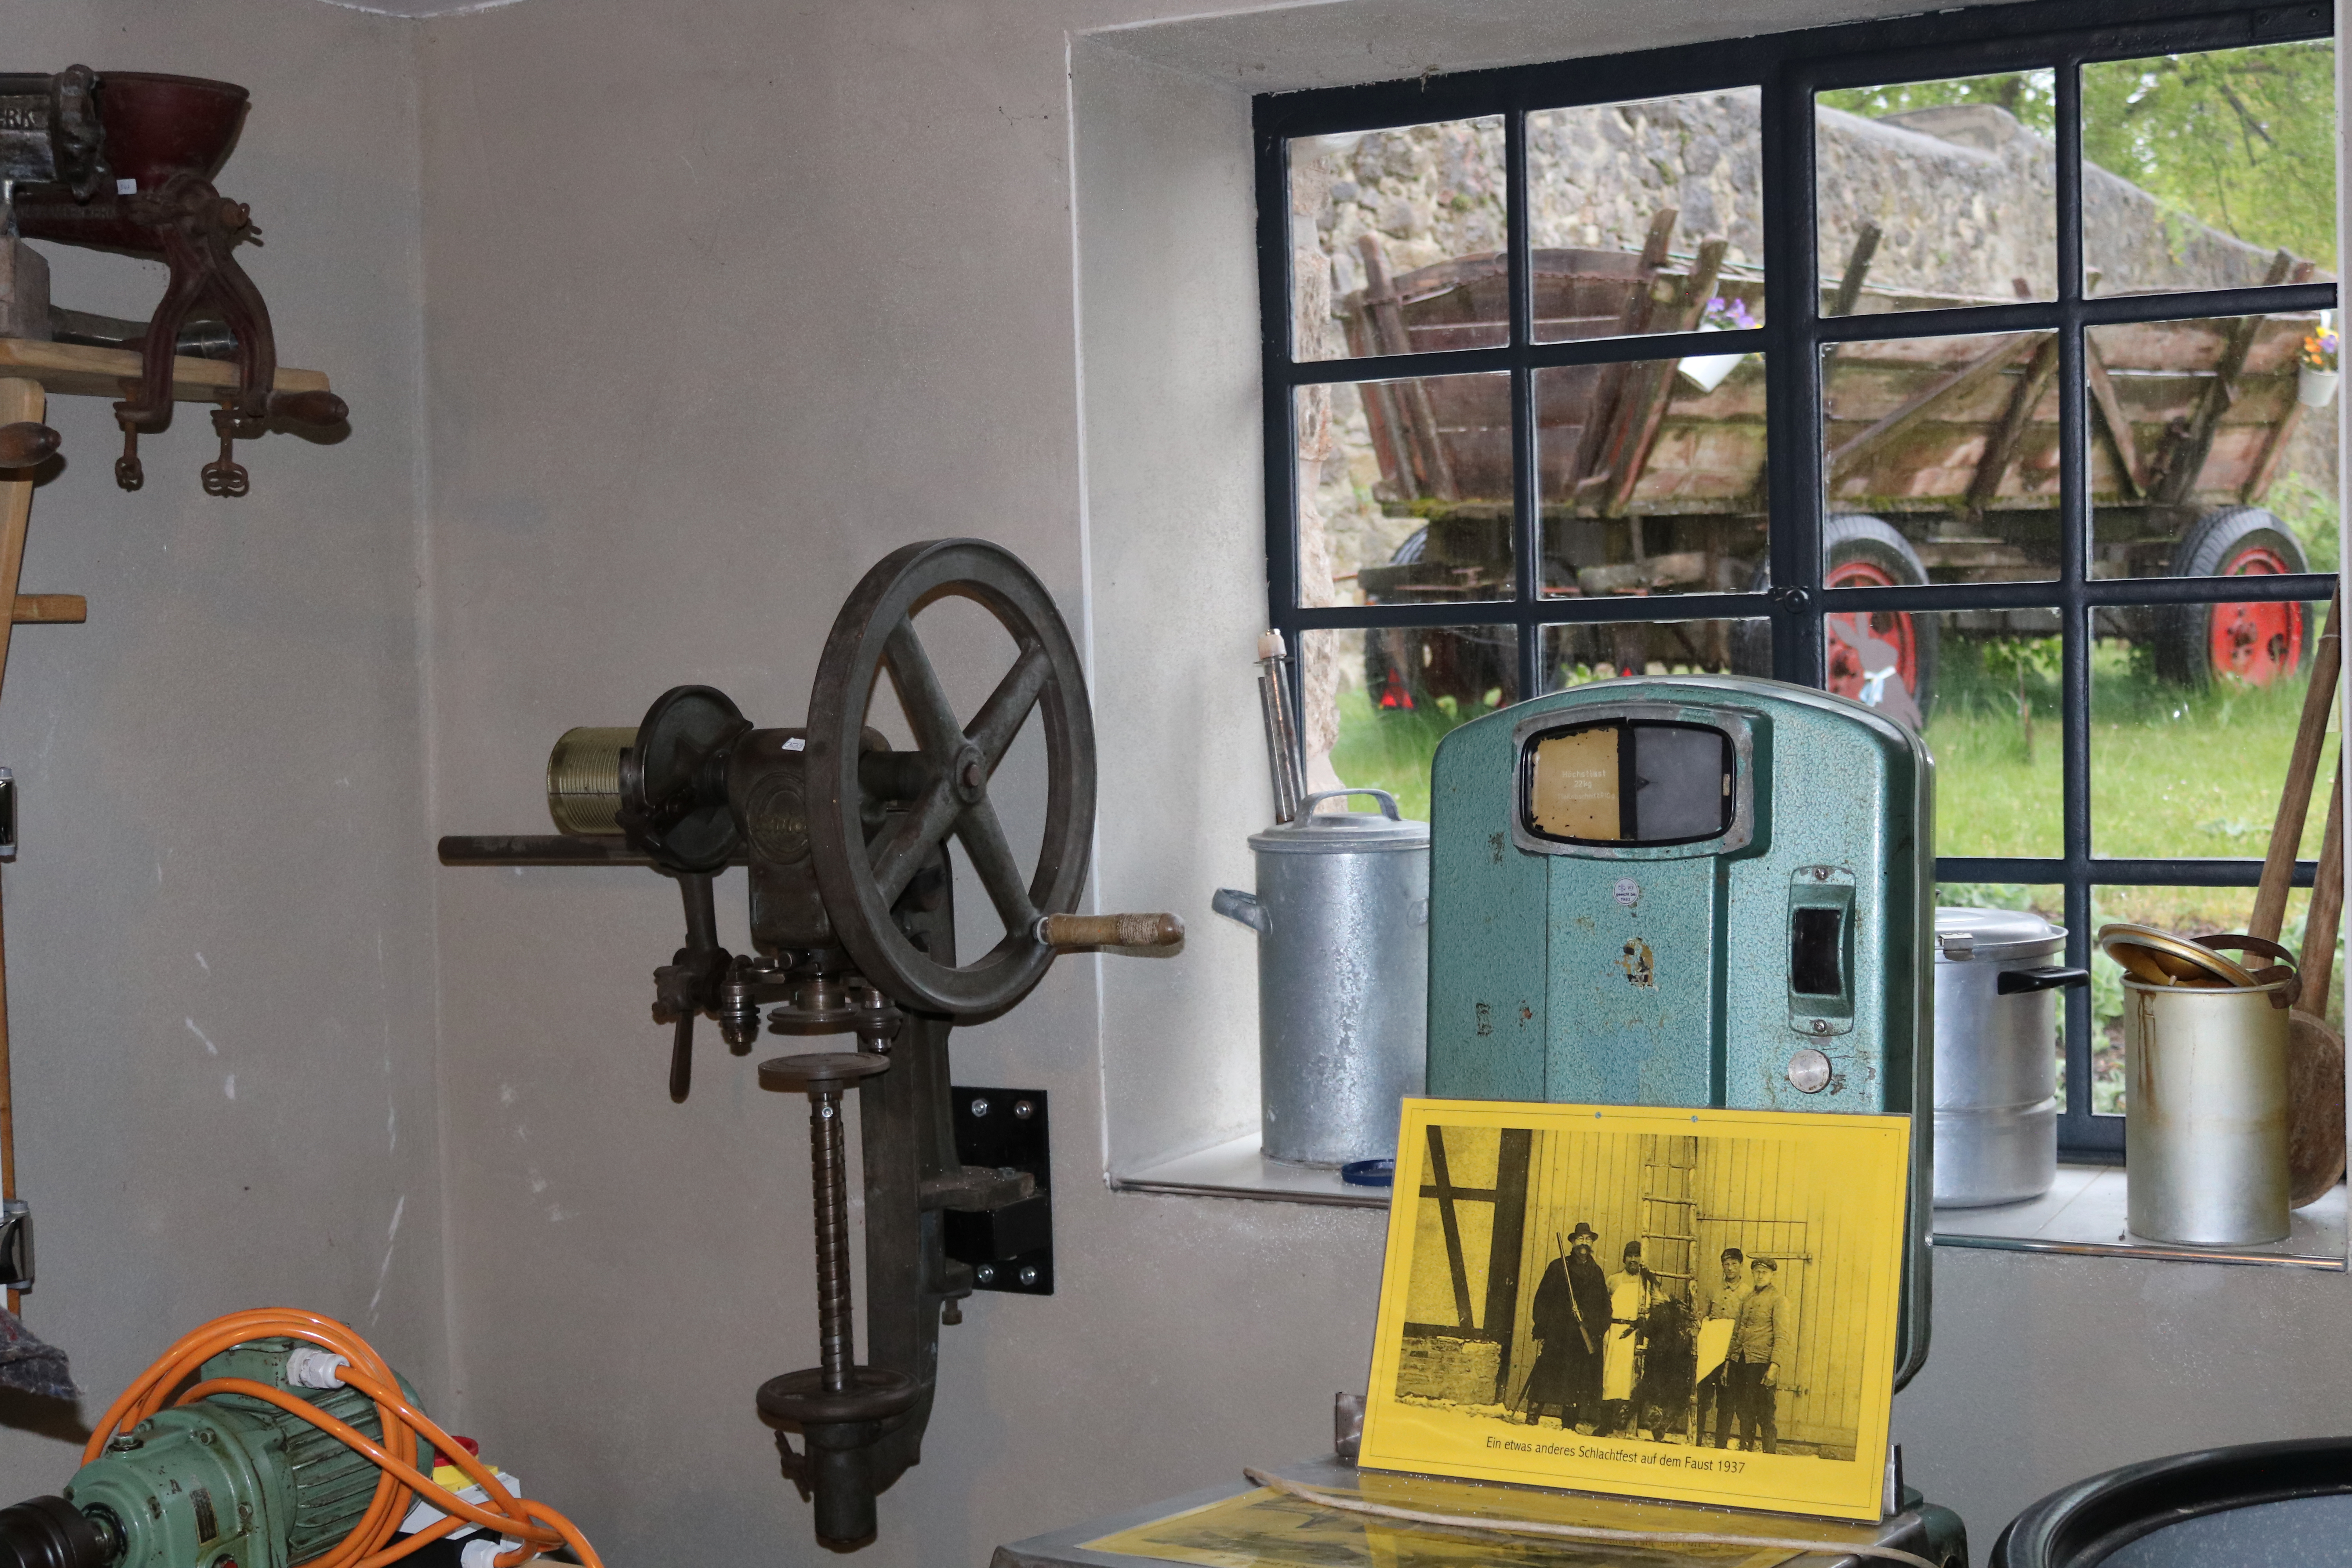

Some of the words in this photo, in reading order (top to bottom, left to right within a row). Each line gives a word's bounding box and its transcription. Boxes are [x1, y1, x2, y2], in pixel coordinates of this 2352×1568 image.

[1487, 1436, 1501, 1448] Ein
[1504, 1441, 1532, 1452] etwas
[1535, 1443, 1575, 1456] anderes
[1579, 1446, 1637, 1463] Schlachtfest
[1641, 1453, 1657, 1465] auf
[1660, 1454, 1681, 1467] dem
[1685, 1456, 1713, 1470] Faust
[1719, 1461, 1745, 1473] 1937
